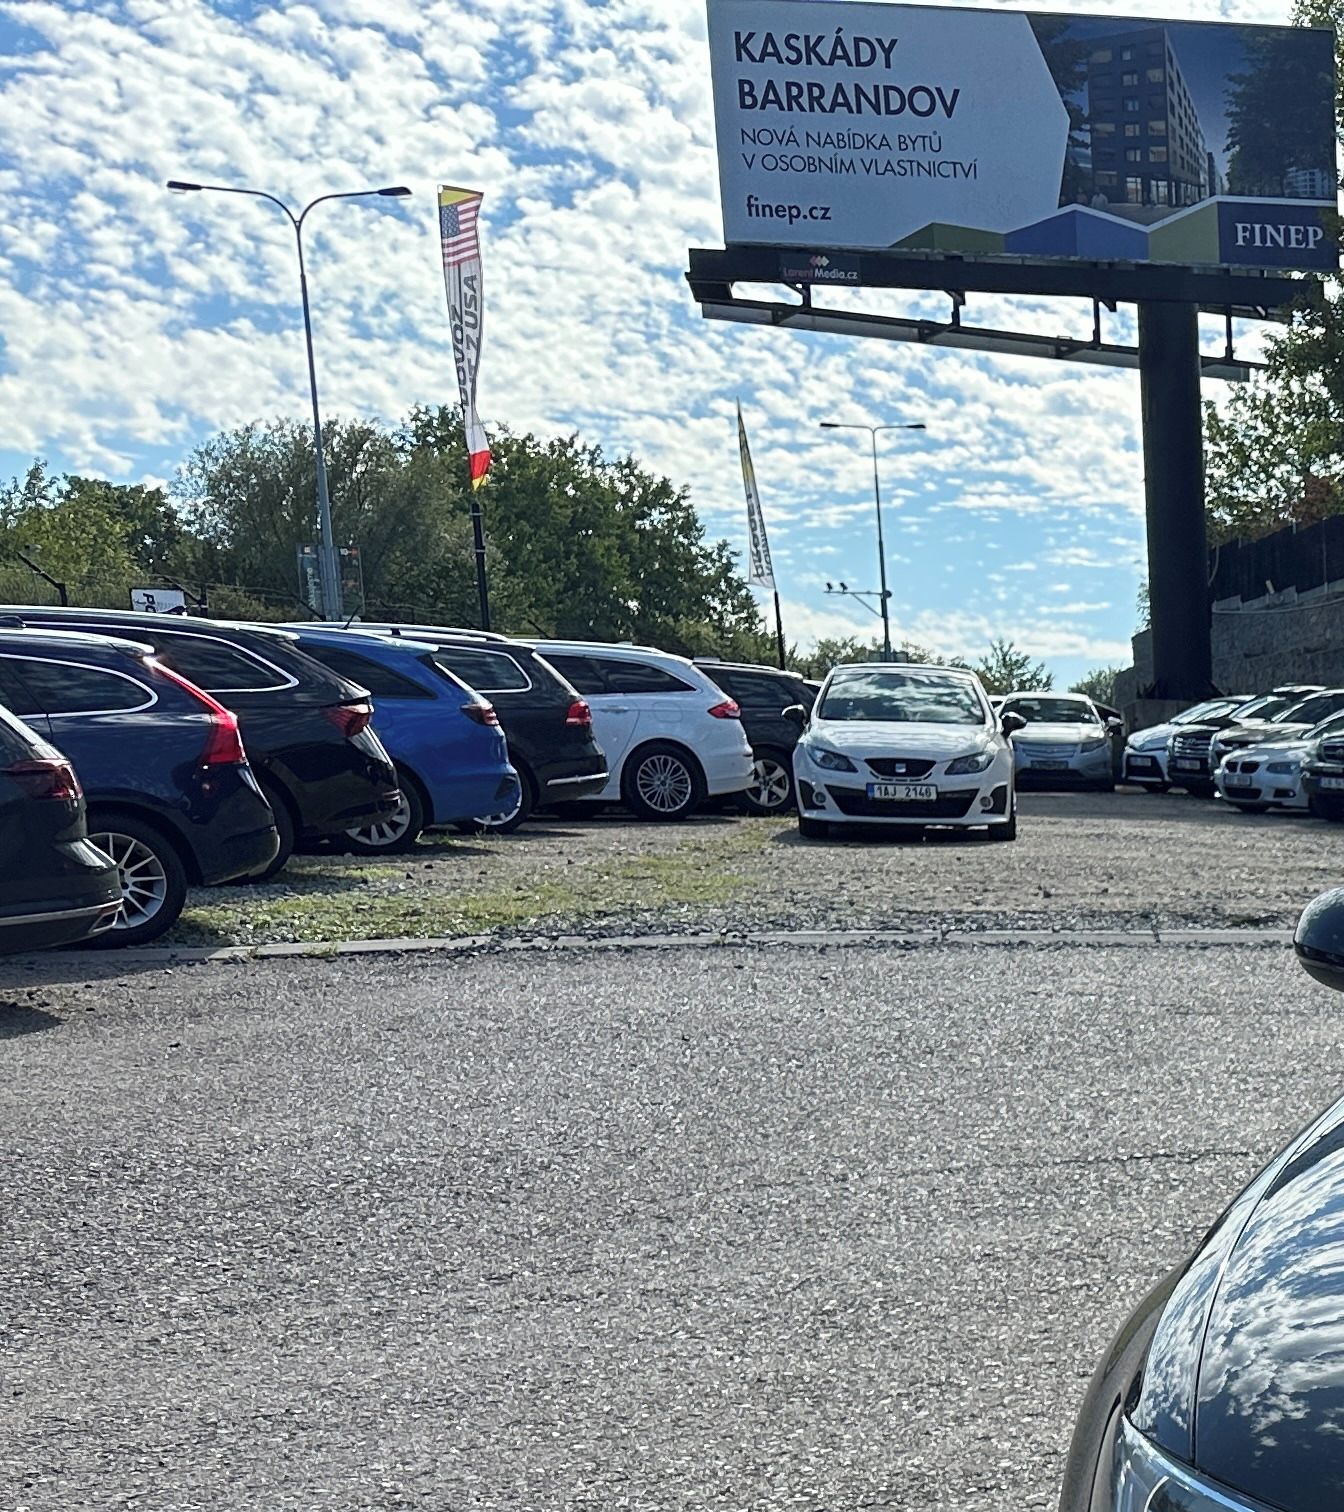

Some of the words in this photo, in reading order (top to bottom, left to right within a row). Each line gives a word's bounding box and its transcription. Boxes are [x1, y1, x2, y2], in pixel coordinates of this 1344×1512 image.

[734, 26, 898, 69] KASKÁDY
[738, 79, 960, 119] BARRANDOV
[741, 125, 800, 148] NOVÁ
[806, 128, 892, 150] NABÍDKA
[898, 131, 942, 153] BYTŮ
[742, 153, 756, 170] V
[761, 153, 857, 175] OSOBNÍM
[860, 158, 978, 180] VLASTNICTVÍ
[747, 195, 832, 225] finep.cz
[1235, 222, 1324, 249] FINEP
[463, 274, 478, 330] USA
